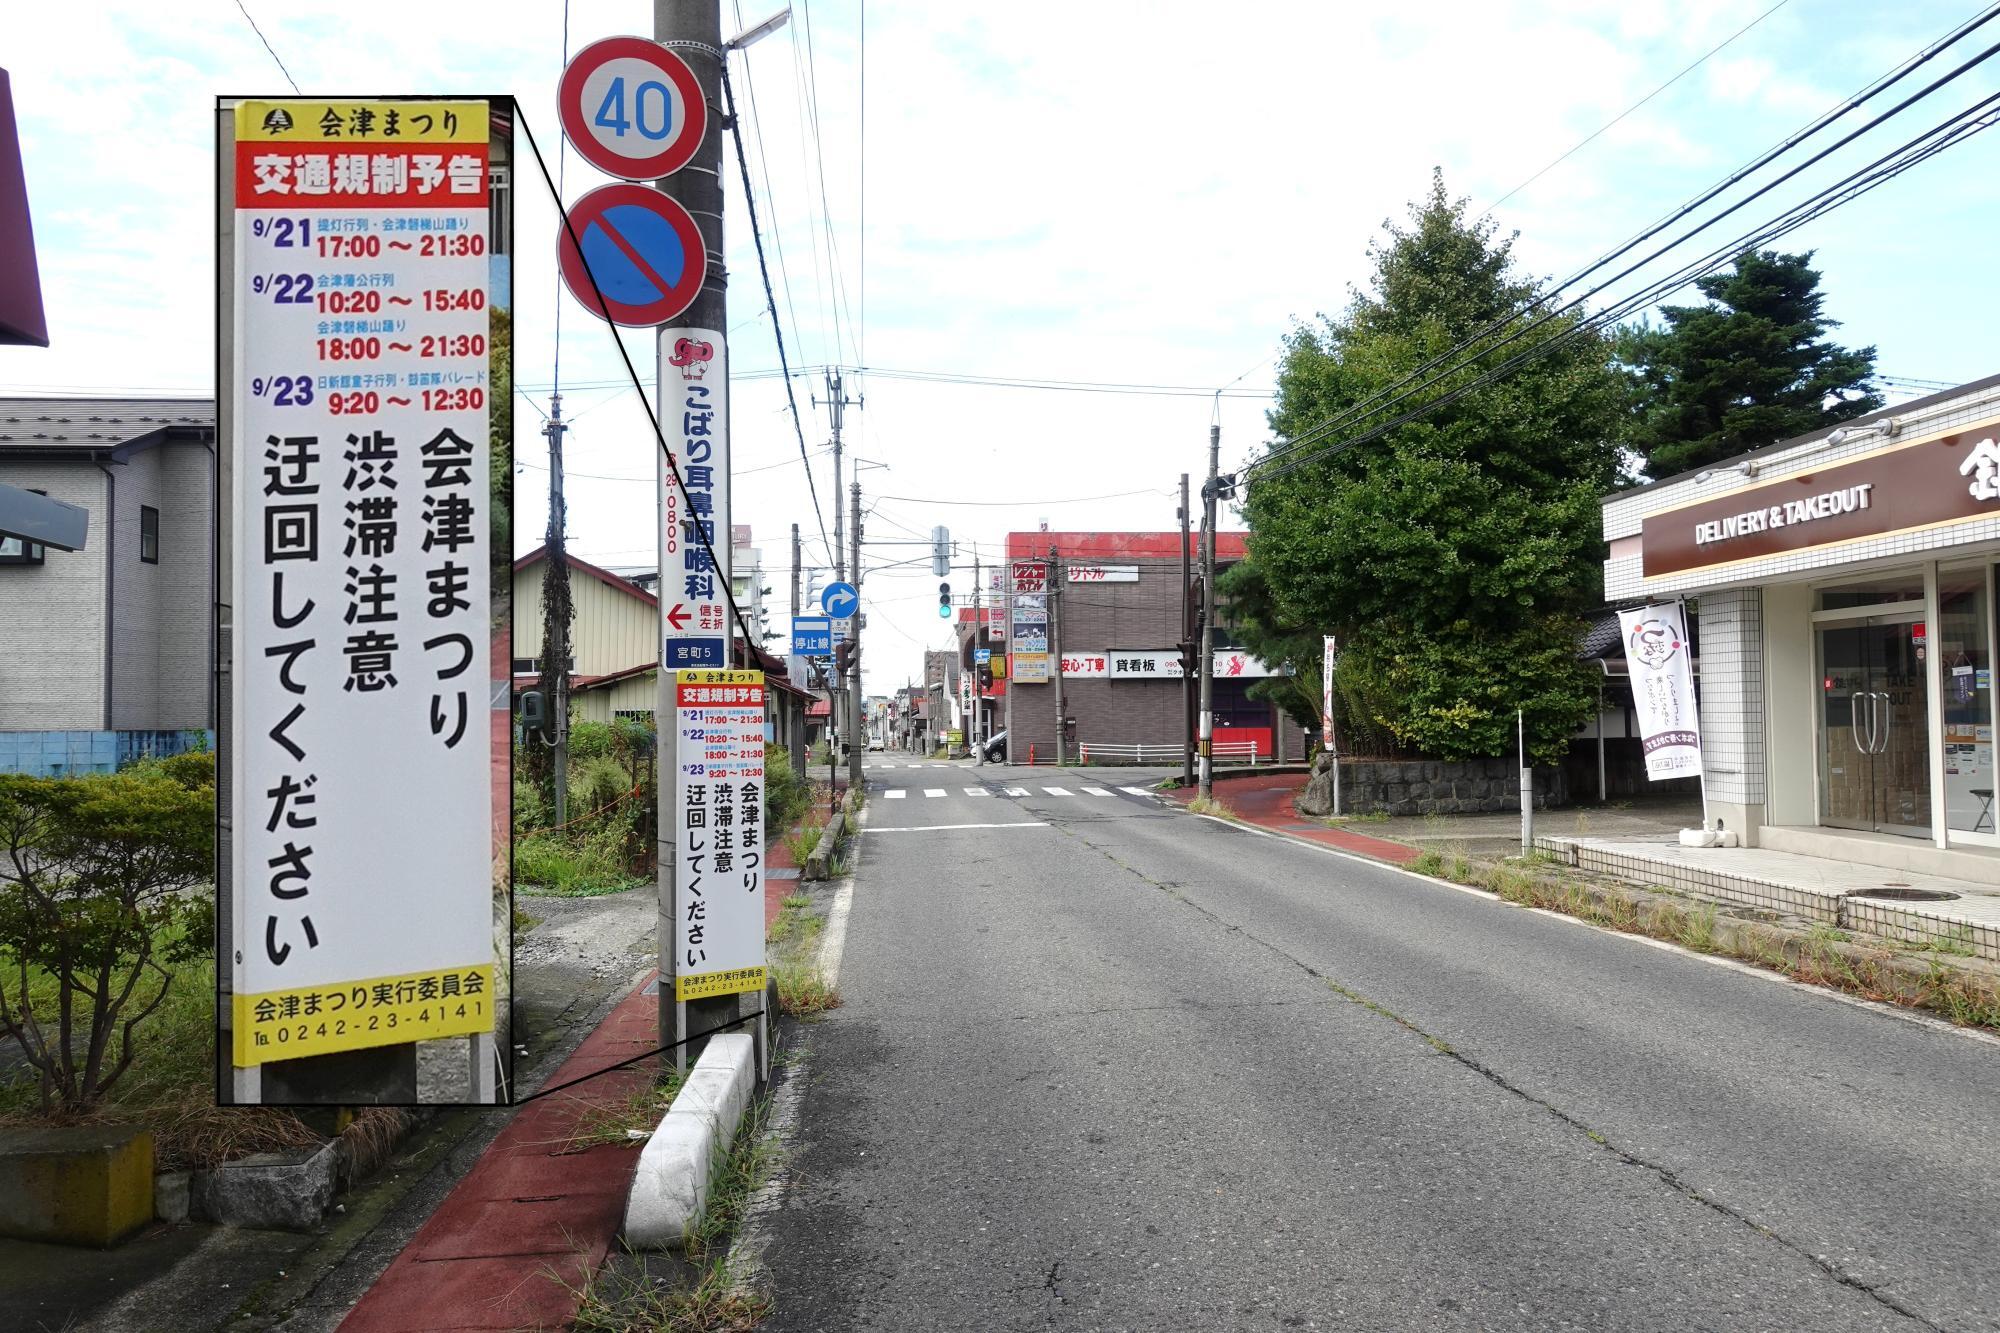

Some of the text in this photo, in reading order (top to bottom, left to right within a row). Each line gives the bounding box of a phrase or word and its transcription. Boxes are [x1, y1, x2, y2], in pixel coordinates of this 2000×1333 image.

[318, 106, 458, 138] 会津まつり
[595, 77, 672, 140] 40
[253, 154, 482, 195] 交通規制予告
[253, 218, 311, 247] 9/21
[253, 274, 314, 304] 9/22
[317, 274, 395, 287] 会津藩公行列
[252, 376, 314, 406] 9/23
[684, 386, 714, 600] こばり耳鼻咽喉科
[342, 430, 398, 692] 渋滞注意
[1015, 566, 1044, 577] レジャー
[420, 427, 475, 749] 会津まつり
[700, 604, 724, 617] 信号
[700, 618, 724, 630] 左折
[796, 638, 829, 649] 停止線
[706, 672, 754, 683] 会津まつり
[1061, 658, 1104, 672] 安心・丁寧
[1116, 659, 1155, 672] 貸看板
[263, 435, 320, 966] 迂回してください
[683, 688, 762, 702] 交通規制予告
[1890, 692, 1912, 705] OUT
[683, 710, 704, 720] 9/21
[682, 729, 704, 740] 9/22
[682, 764, 704, 775] 9/23
[714, 783, 733, 873] 渋滞注意
[740, 782, 759, 892] 会津まつり
[687, 784, 706, 967] 迂回してください
[684, 969, 763, 987] 会津まつり実行委員会
[254, 971, 484, 1023] 会津まつり実行委員会
[278, 1001, 483, 1043] 0242-23-4141
